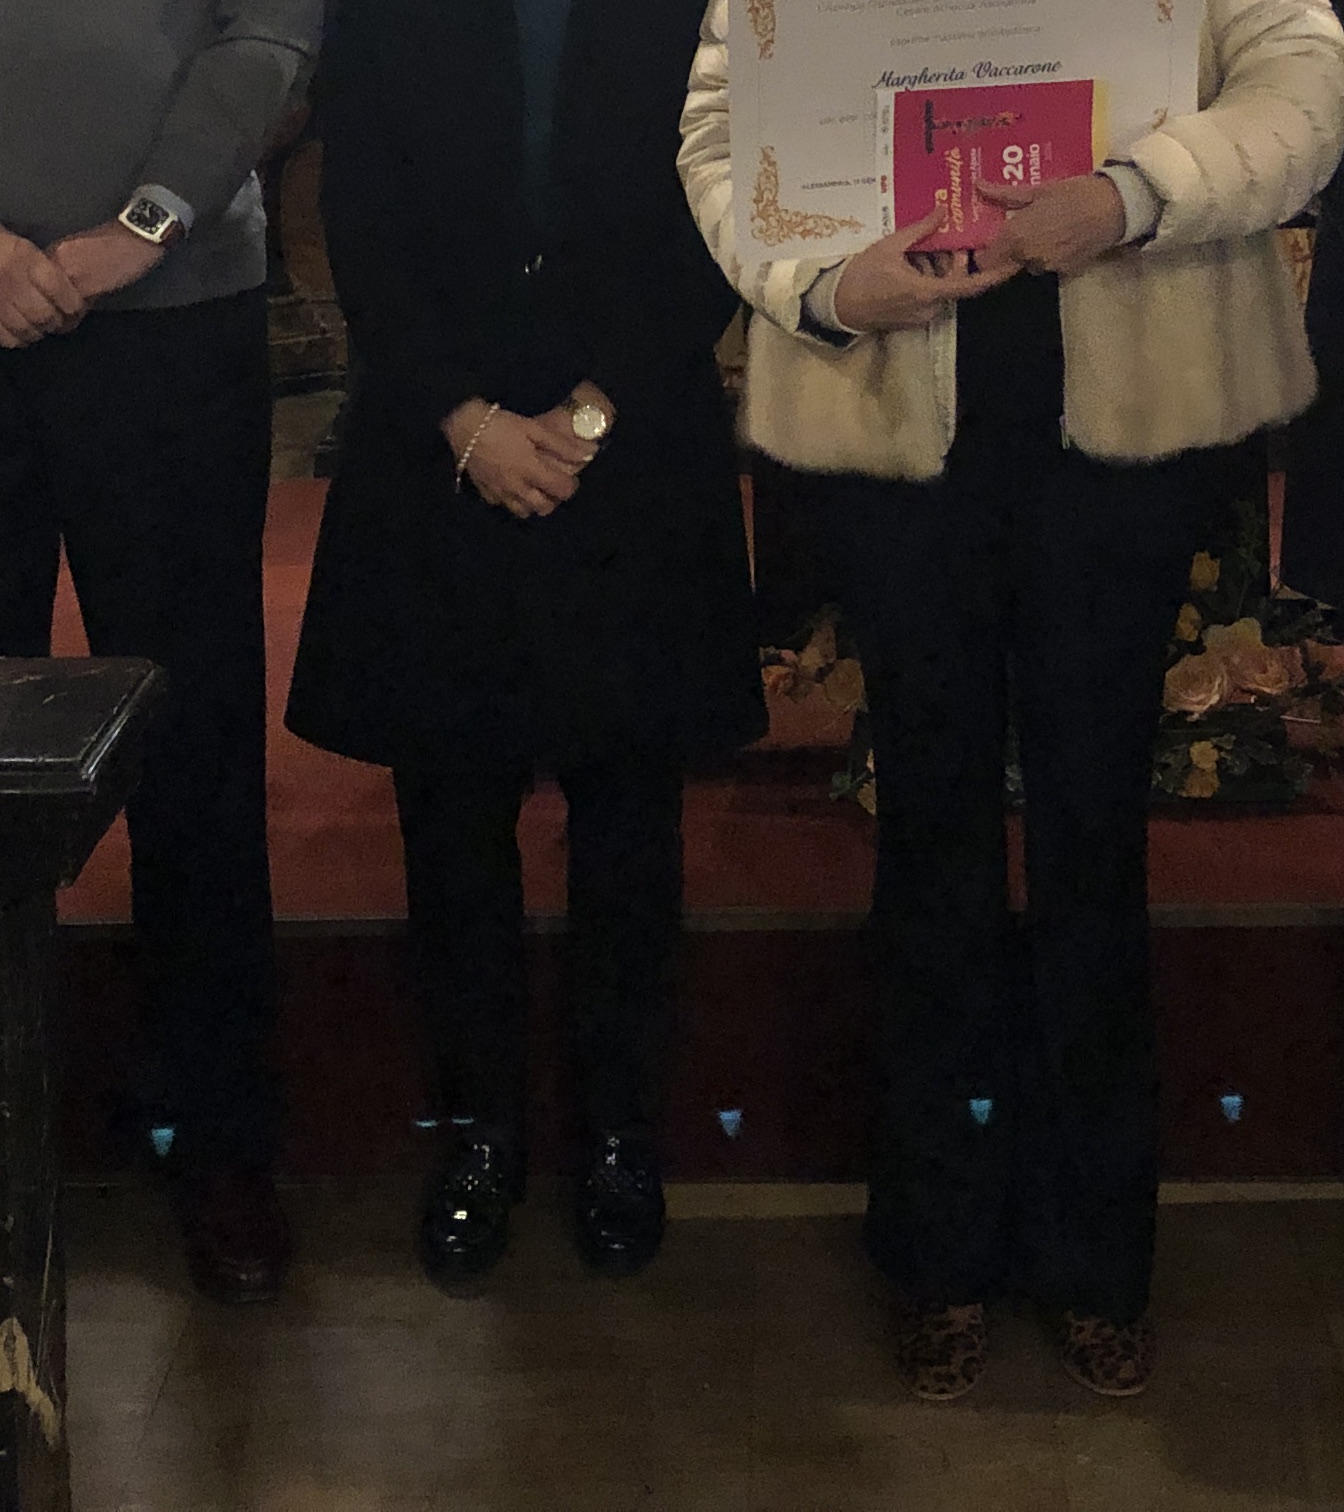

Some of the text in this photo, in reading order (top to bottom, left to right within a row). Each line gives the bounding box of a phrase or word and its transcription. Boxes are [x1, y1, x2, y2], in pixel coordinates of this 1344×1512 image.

[871, 60, 1062, 91] Margherita Vaccarone
[1026, 143, 1042, 186] nnaio
